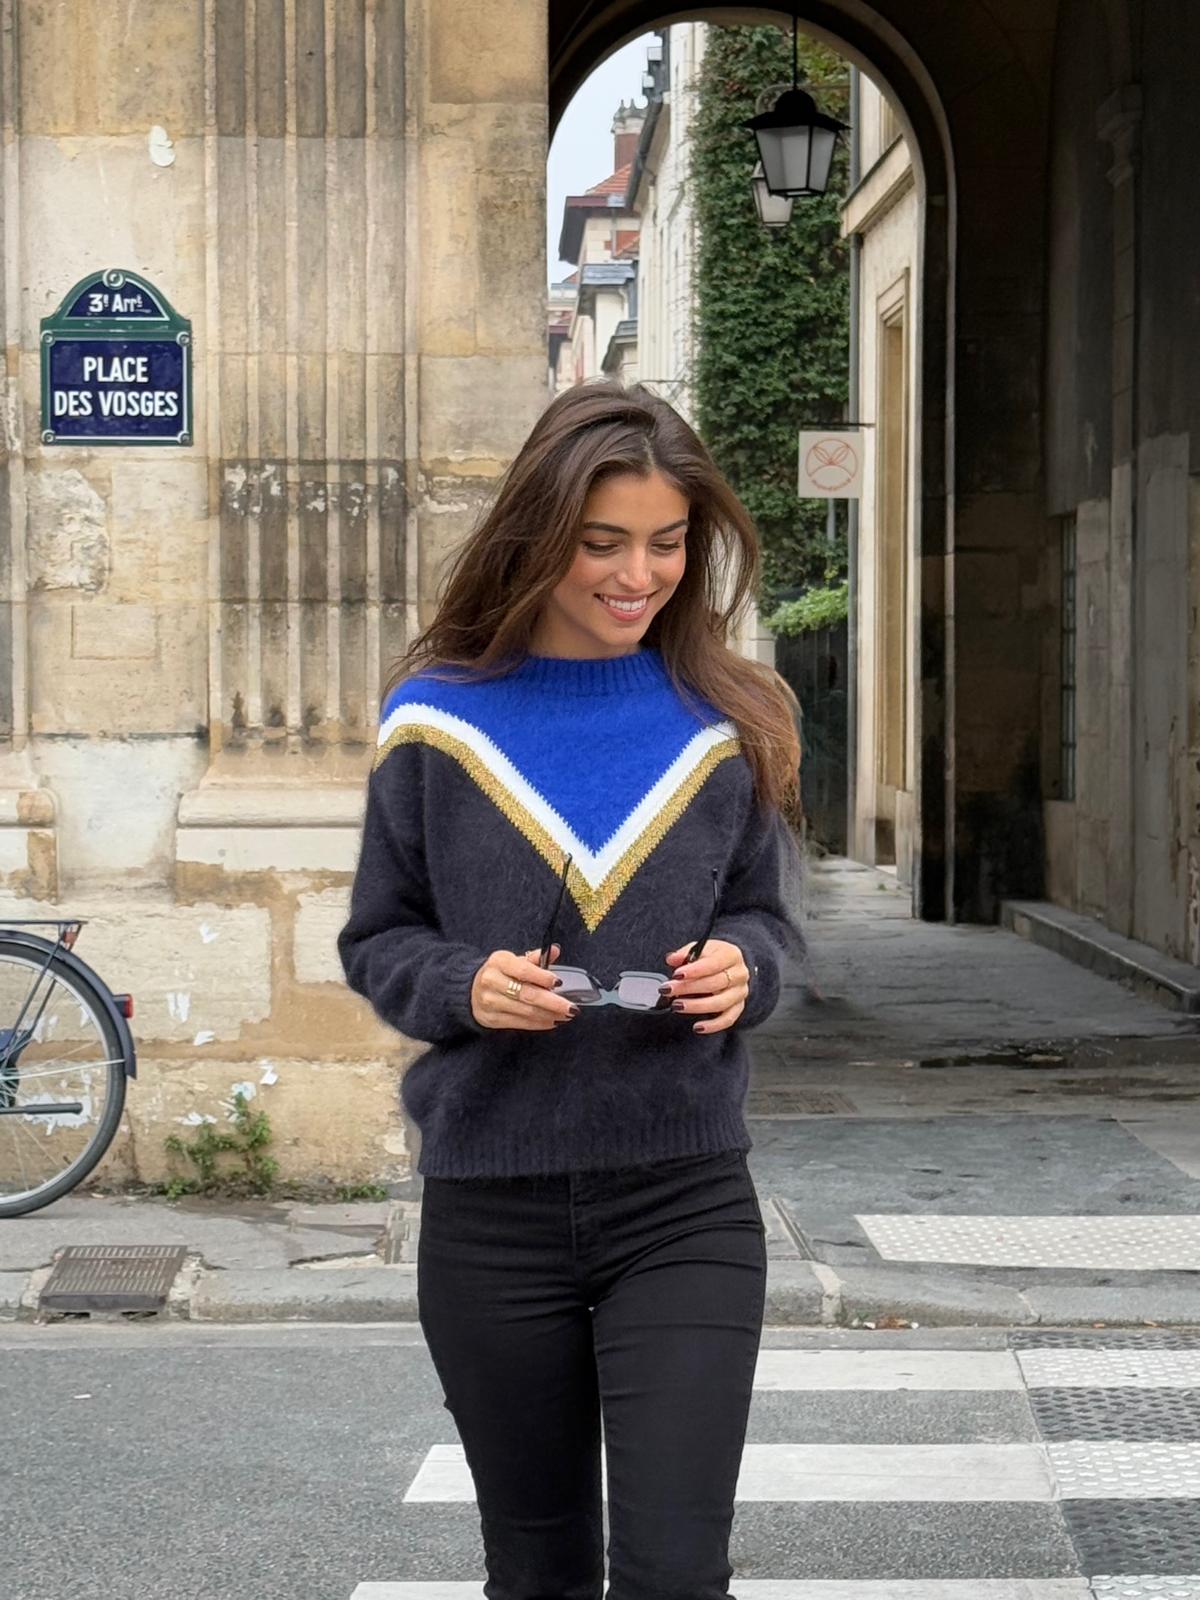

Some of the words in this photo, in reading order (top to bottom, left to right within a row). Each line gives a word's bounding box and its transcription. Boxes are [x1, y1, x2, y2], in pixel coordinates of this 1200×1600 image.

[83, 356, 149, 383] PLACE
[54, 390, 93, 417] DES
[99, 390, 179, 417] VOSGES
